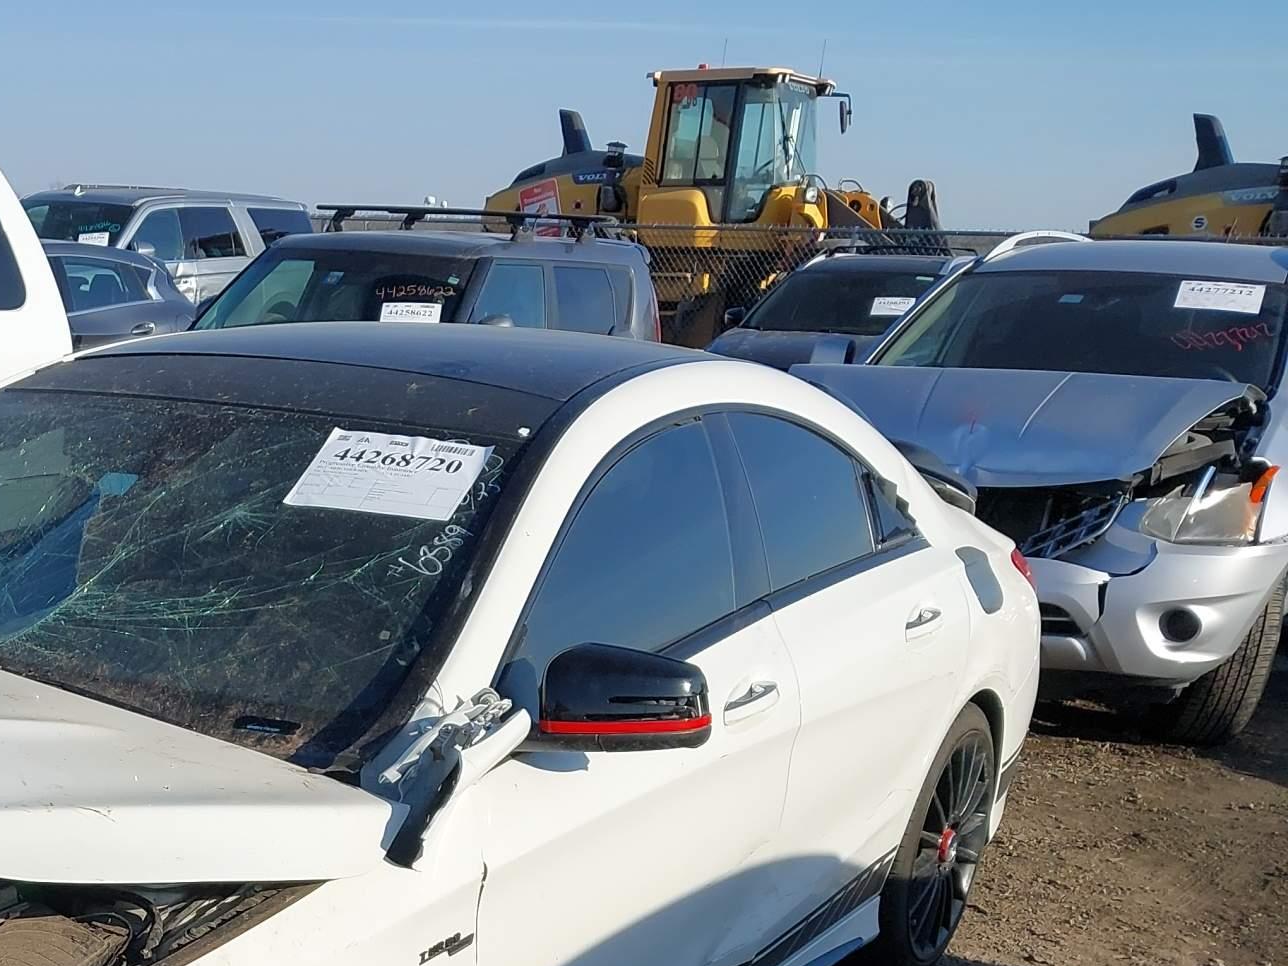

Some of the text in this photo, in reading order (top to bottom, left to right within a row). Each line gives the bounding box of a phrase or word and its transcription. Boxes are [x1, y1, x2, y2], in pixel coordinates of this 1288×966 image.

[376, 284, 457, 299] 44258622
[1187, 286, 1255, 297] 44277212
[386, 308, 434, 318] 44258622
[333, 446, 464, 475] 44268720
